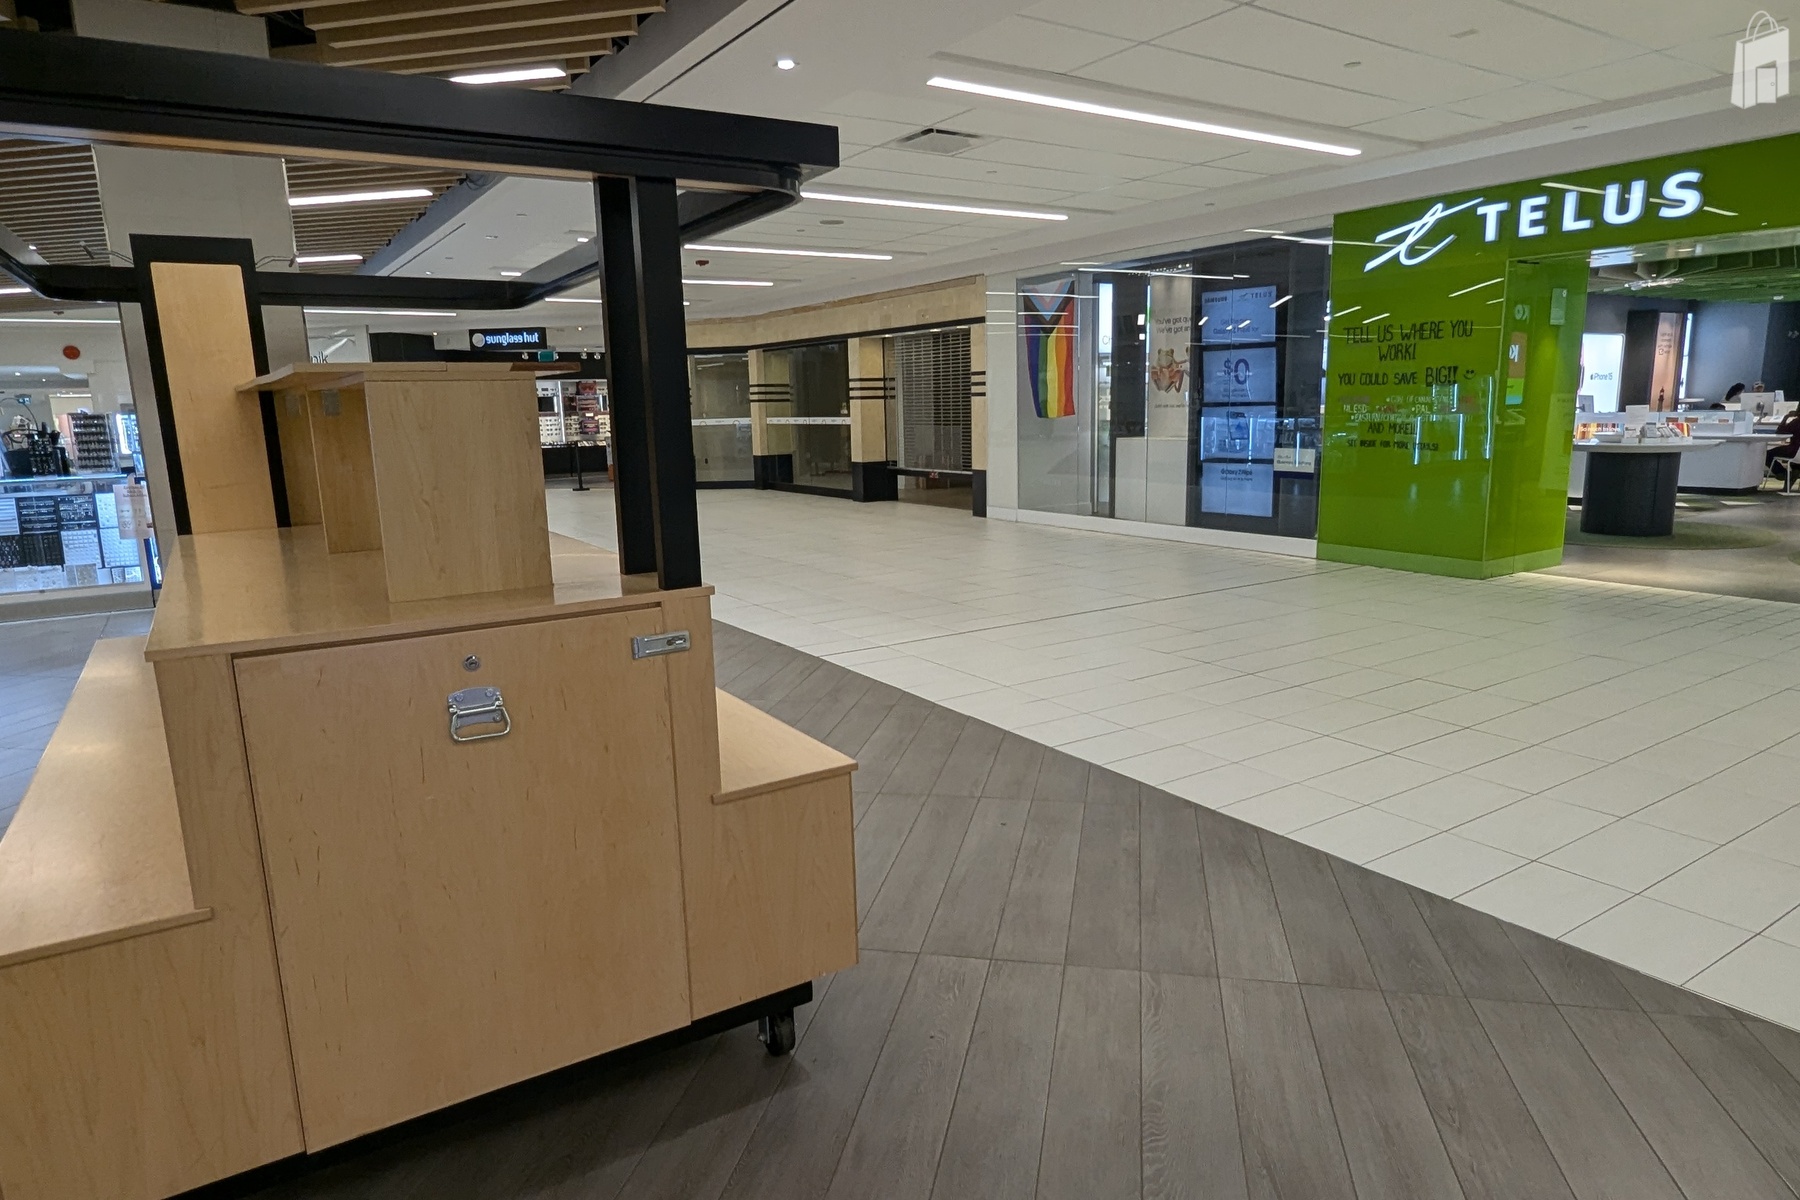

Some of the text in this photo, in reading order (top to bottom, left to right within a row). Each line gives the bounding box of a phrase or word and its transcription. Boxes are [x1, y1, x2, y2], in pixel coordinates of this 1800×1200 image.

[1476, 171, 1703, 243] TELUS
[485, 331, 539, 346] sunglass hut
[1343, 319, 1474, 344] TELL US WHERE YOU
[1338, 366, 1459, 387] YOU COULD SAVE BIG!!
[1593, 372, 1607, 380] iPhone
[1367, 423, 1385, 433] AND
